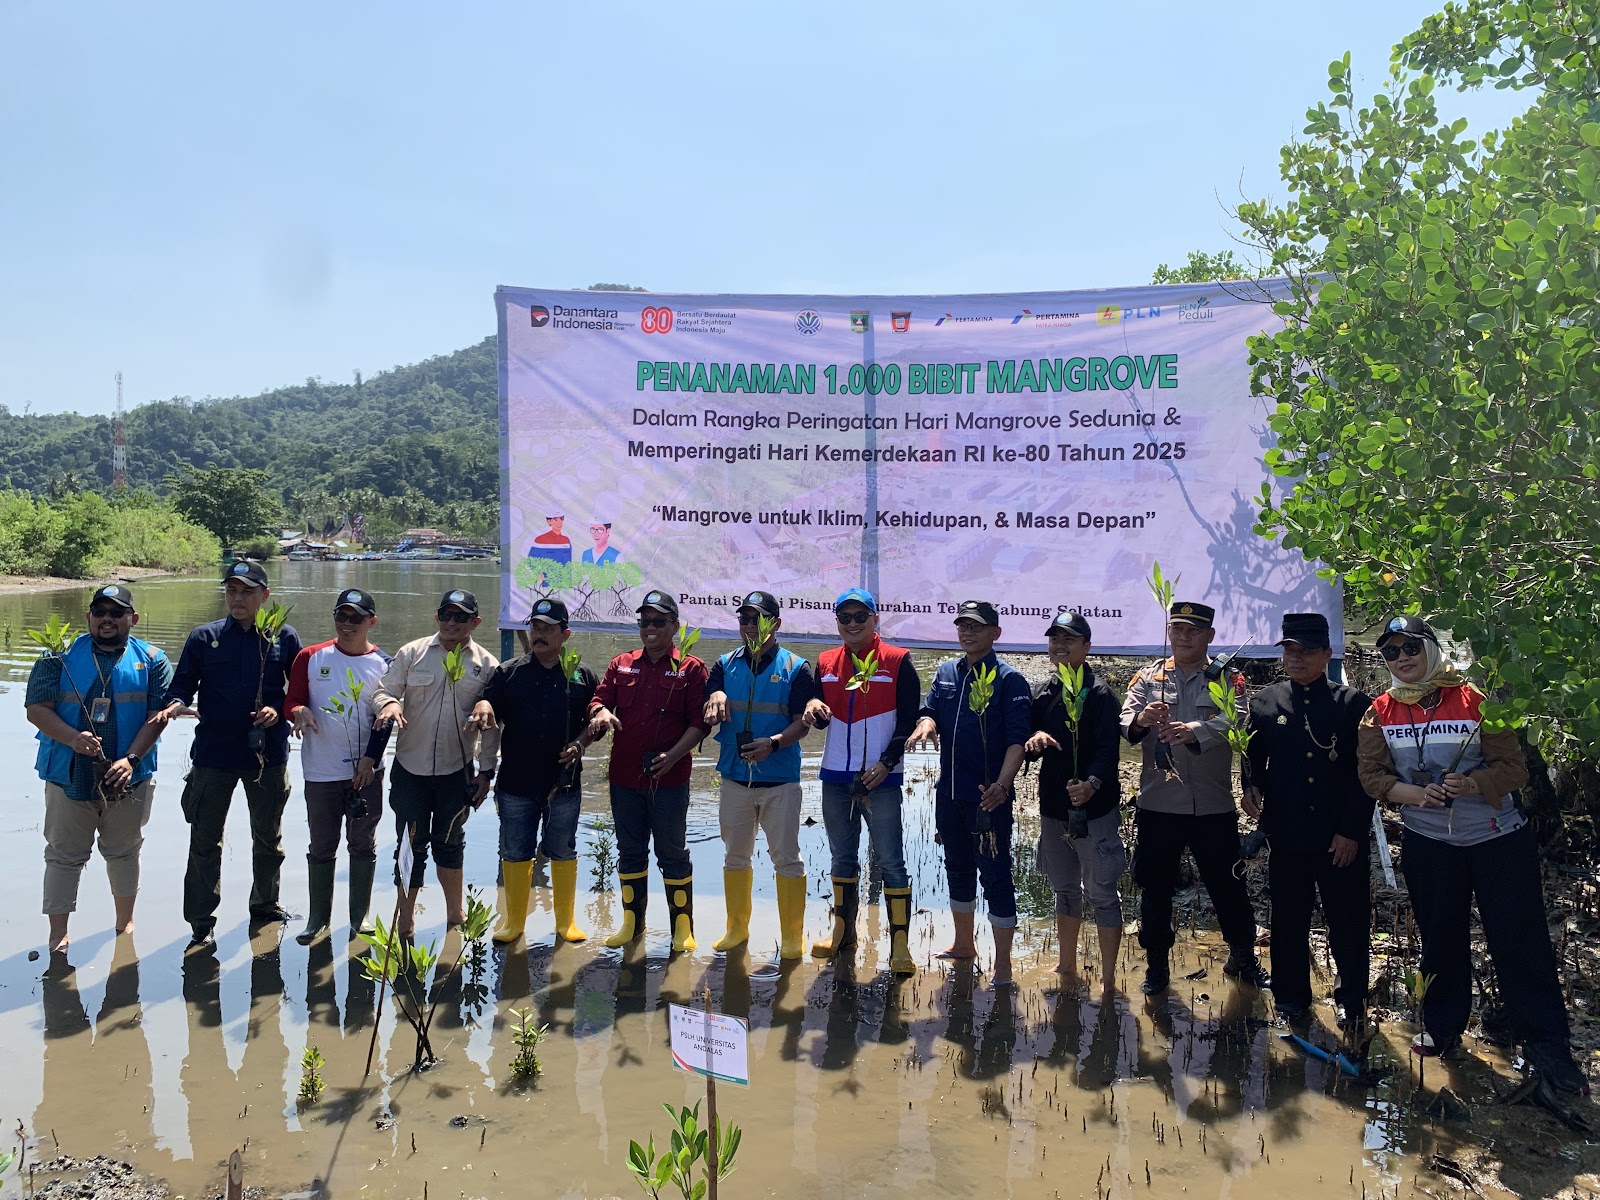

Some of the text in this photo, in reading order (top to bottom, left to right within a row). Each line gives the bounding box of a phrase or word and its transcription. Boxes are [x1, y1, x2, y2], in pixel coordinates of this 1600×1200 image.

[553, 305, 618, 319] Danantara
[640, 306, 674, 334] 80
[1123, 307, 1160, 319] PLN
[1178, 308, 1213, 320] Peduli
[553, 317, 613, 331] Indonesia
[637, 354, 1178, 395] PENANAMAN 1.000 BIBIT MANGROVE
[632, 407, 1181, 432] Dalam Rangka Peringatan Hari Mangrove Sedunia &
[628, 440, 1186, 464] Memperingati Hari Kemerdekaan RI ke-80 Tahun 2025
[652, 505, 1156, 533] “Mangrove untuk Iklim, Kehidupan, & Masa Depan”
[679, 593, 727, 606] Pantai
[876, 601, 932, 613] urahan
[937, 602, 961, 614] Tel
[991, 603, 1052, 619] abung
[1387, 723, 1470, 740] PERTAMINA
[680, 1031, 736, 1050] PSLH UNIVERSITAS
[693, 1043, 723, 1056] ANDALAS
